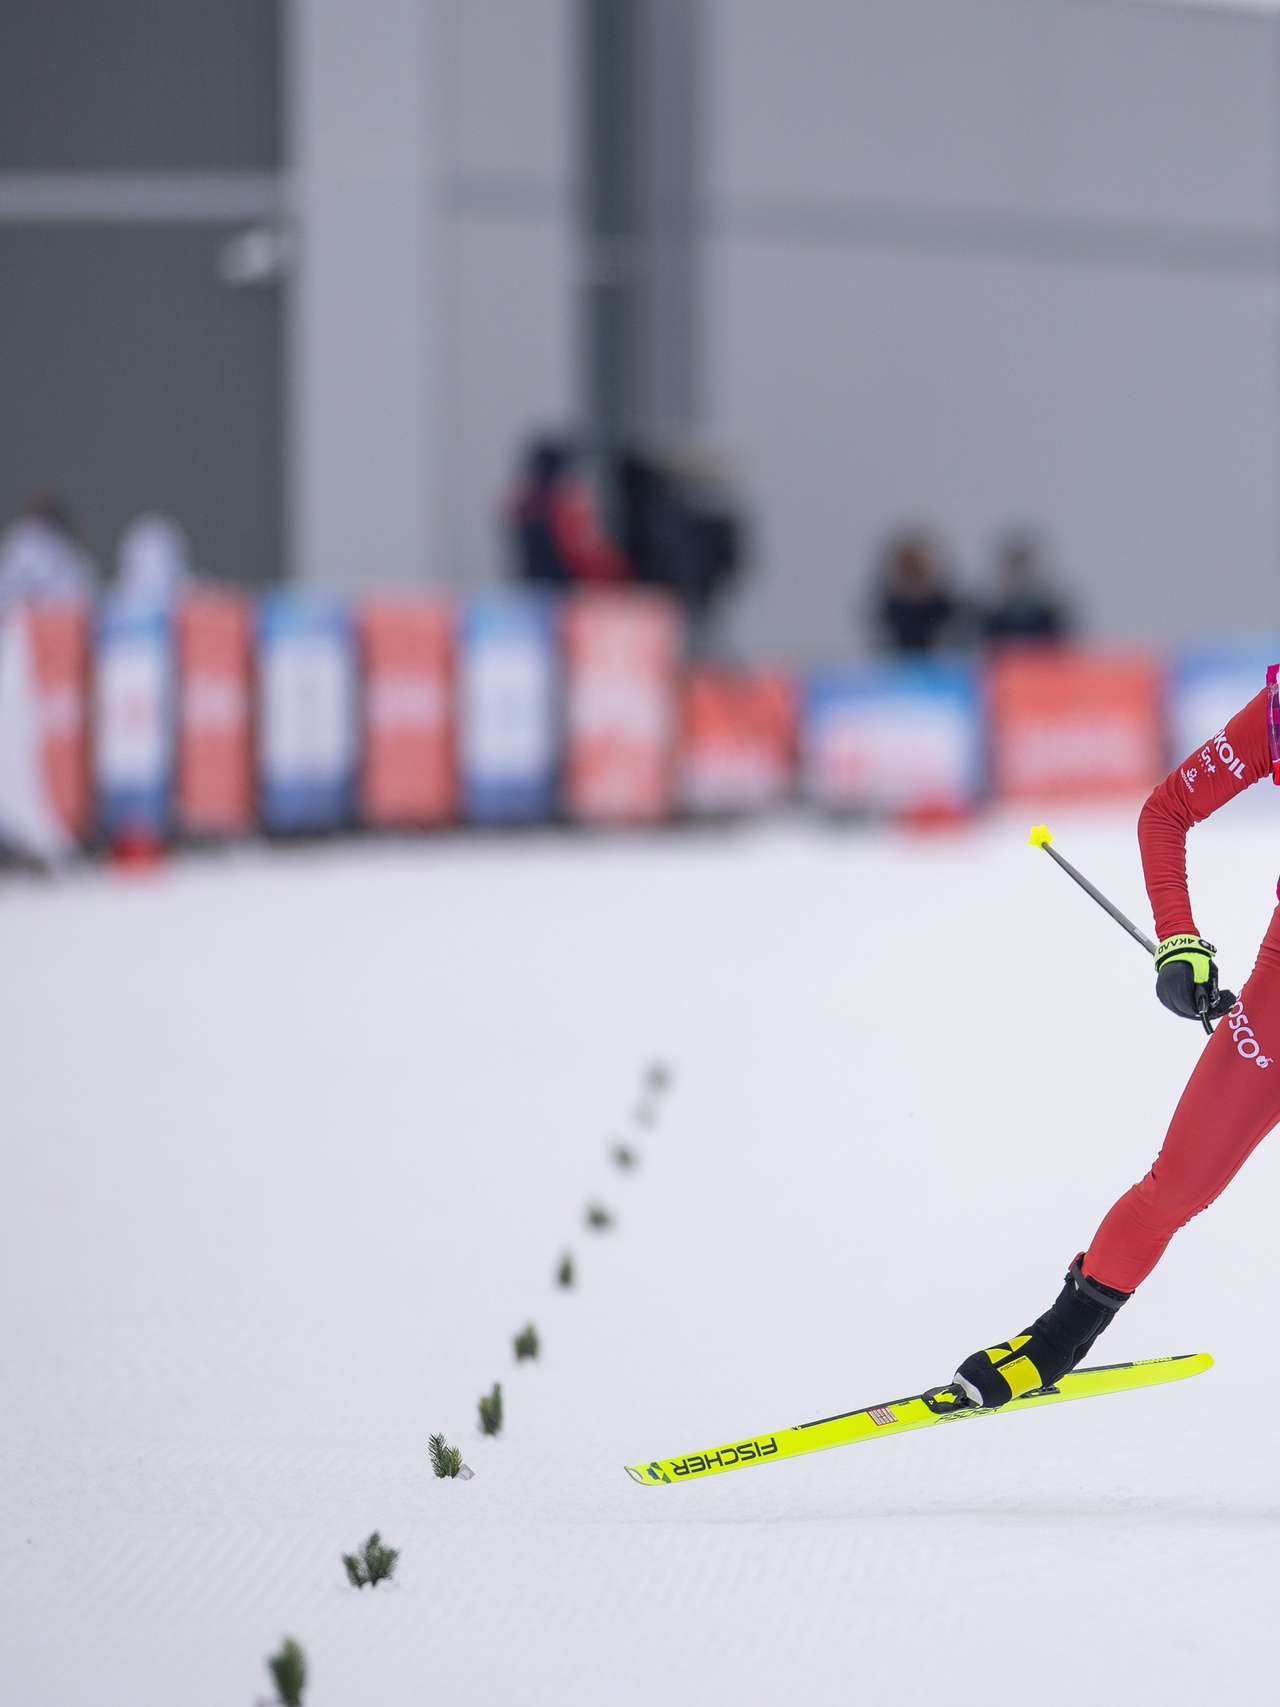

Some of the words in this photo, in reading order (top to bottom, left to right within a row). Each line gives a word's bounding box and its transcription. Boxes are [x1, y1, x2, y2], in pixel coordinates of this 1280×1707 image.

[1213, 729, 1246, 780] KOIL
[1228, 991, 1260, 1059] OSCO
[999, 1356, 1027, 1372] FISCHER
[670, 1437, 778, 1476] FISCHER
